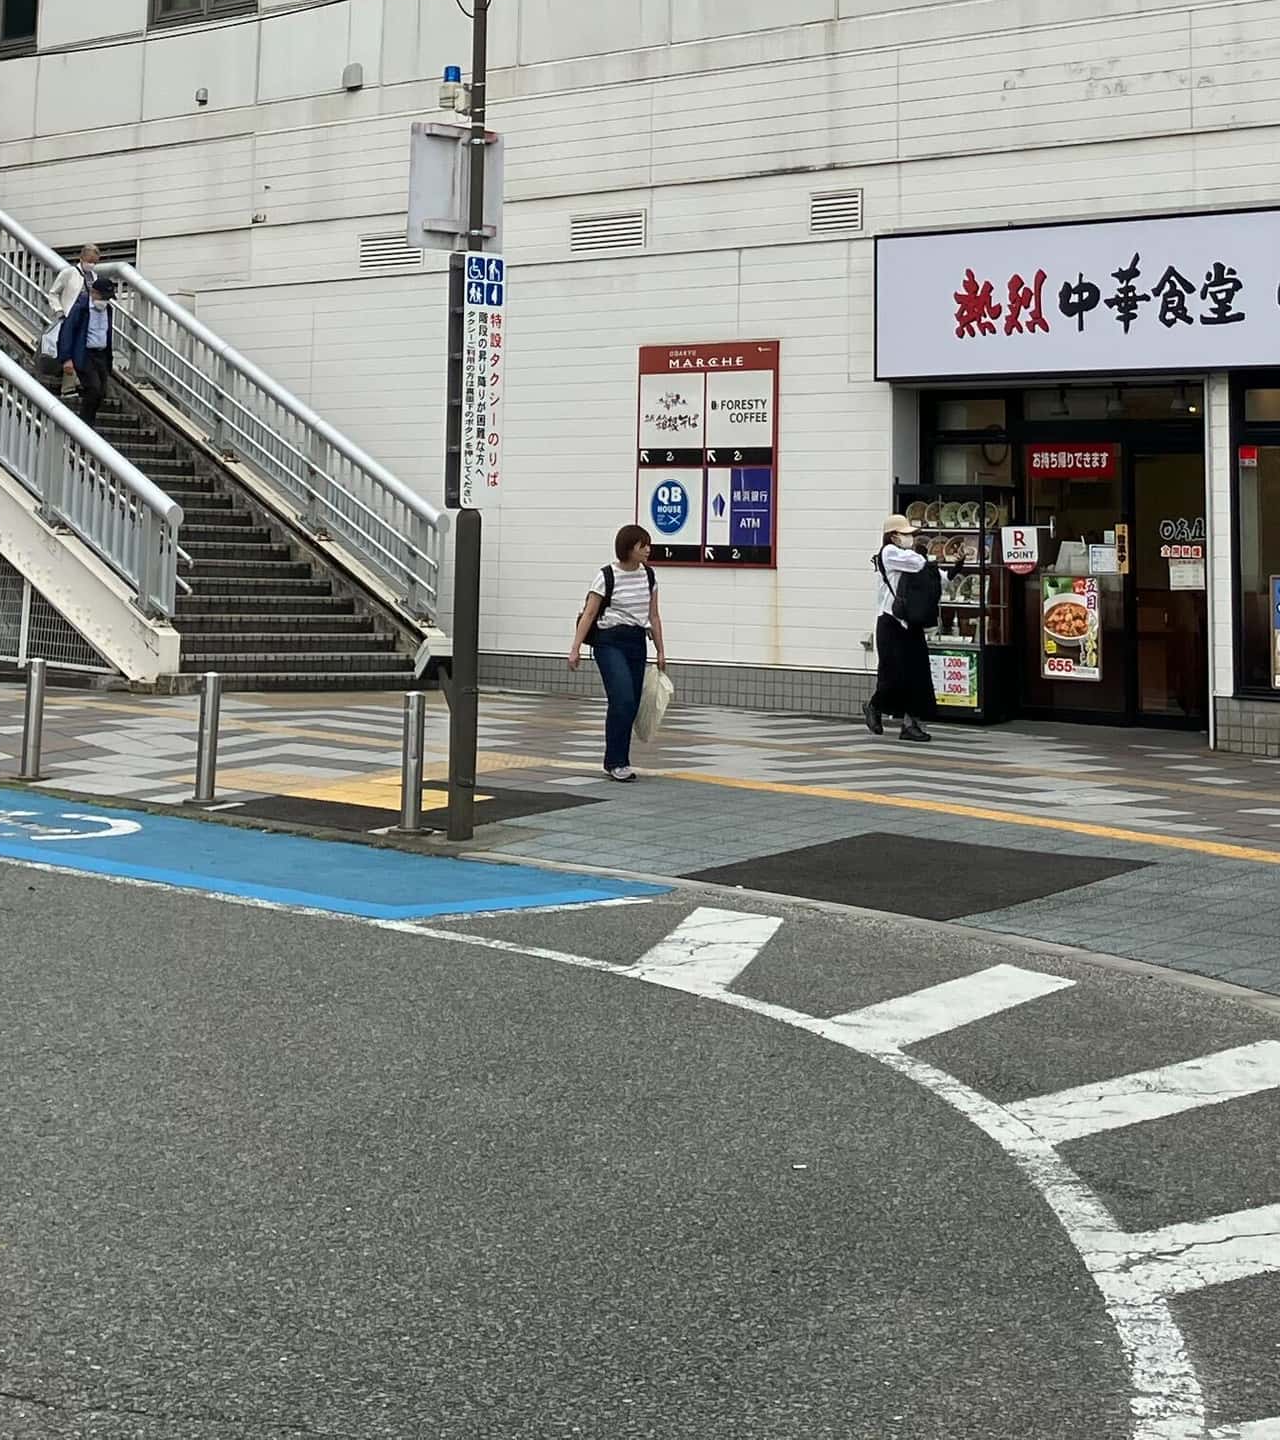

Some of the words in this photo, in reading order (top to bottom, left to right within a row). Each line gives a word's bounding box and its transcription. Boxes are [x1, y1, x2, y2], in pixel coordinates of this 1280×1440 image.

[669, 356, 744, 369] MARCHE
[486, 312, 502, 488] 特設タクシーのりば
[720, 399, 767, 410] FORESTY
[729, 412, 768, 423] COFFEE
[1032, 451, 1109, 469] お持ち帰りできます
[657, 486, 682, 505] QB
[732, 490, 768, 502] 横浜銀行
[657, 505, 682, 513] HOUSE
[739, 518, 760, 528] ATM
[1013, 530, 1027, 547] R
[1007, 550, 1034, 560] POINT
